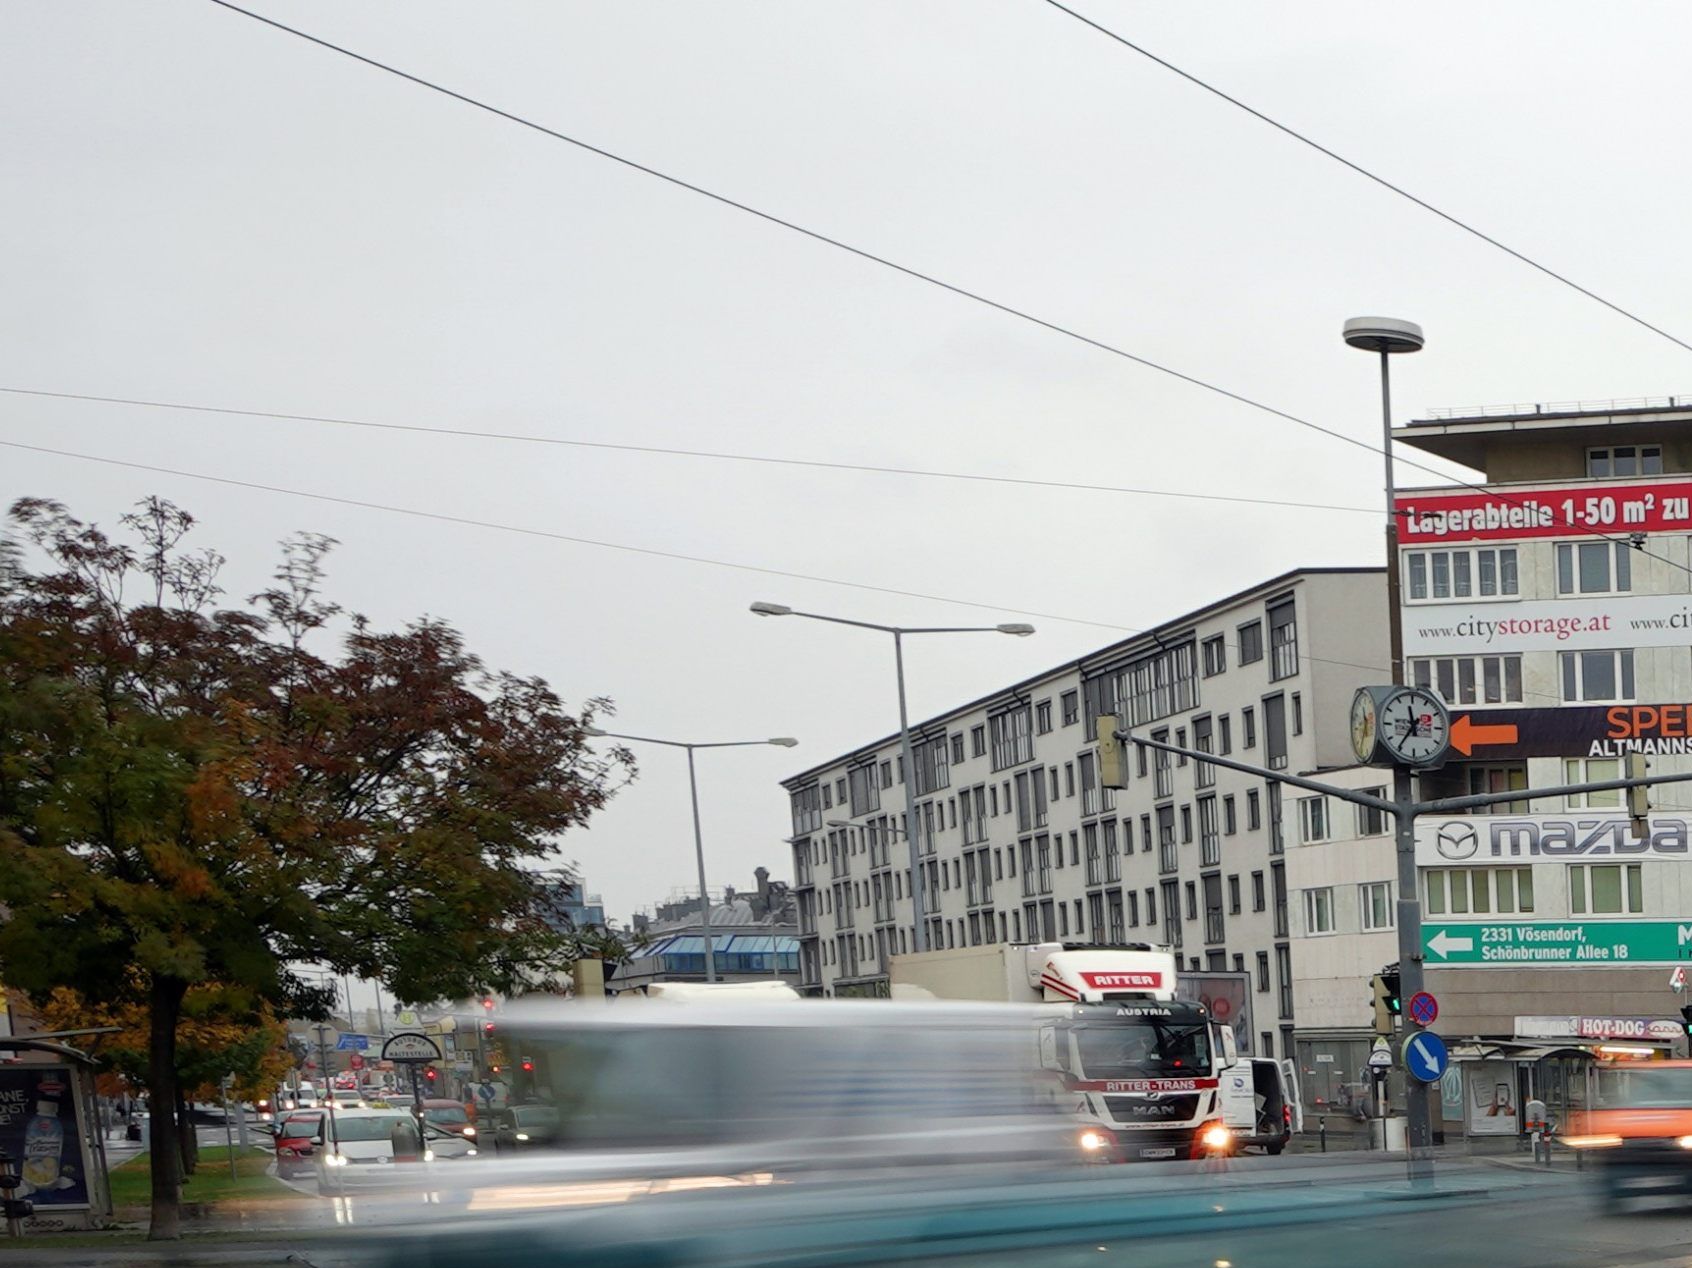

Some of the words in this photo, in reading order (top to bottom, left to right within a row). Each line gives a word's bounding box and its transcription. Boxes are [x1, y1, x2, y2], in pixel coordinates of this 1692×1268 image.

[1407, 501, 1553, 535] Lagerabteile
[1561, 496, 1615, 525] 1-50
[1663, 498, 1690, 521] zu
[1418, 613, 1612, 643] www.citystorage.at
[1481, 927, 1513, 942] 2331
[1517, 925, 1586, 943] Vösendorf,
[1481, 945, 1572, 961] Schönbrunner
[1576, 945, 1609, 960] Allee
[1613, 945, 1629, 959] 18
[1094, 975, 1154, 985] RITTER
[1116, 1008, 1172, 1016] AUSTRIA
[1583, 1020, 1645, 1035] HOT-DOG
[1106, 1080, 1196, 1091] RITTER-TRANS
[1133, 1106, 1175, 1115] MAN
